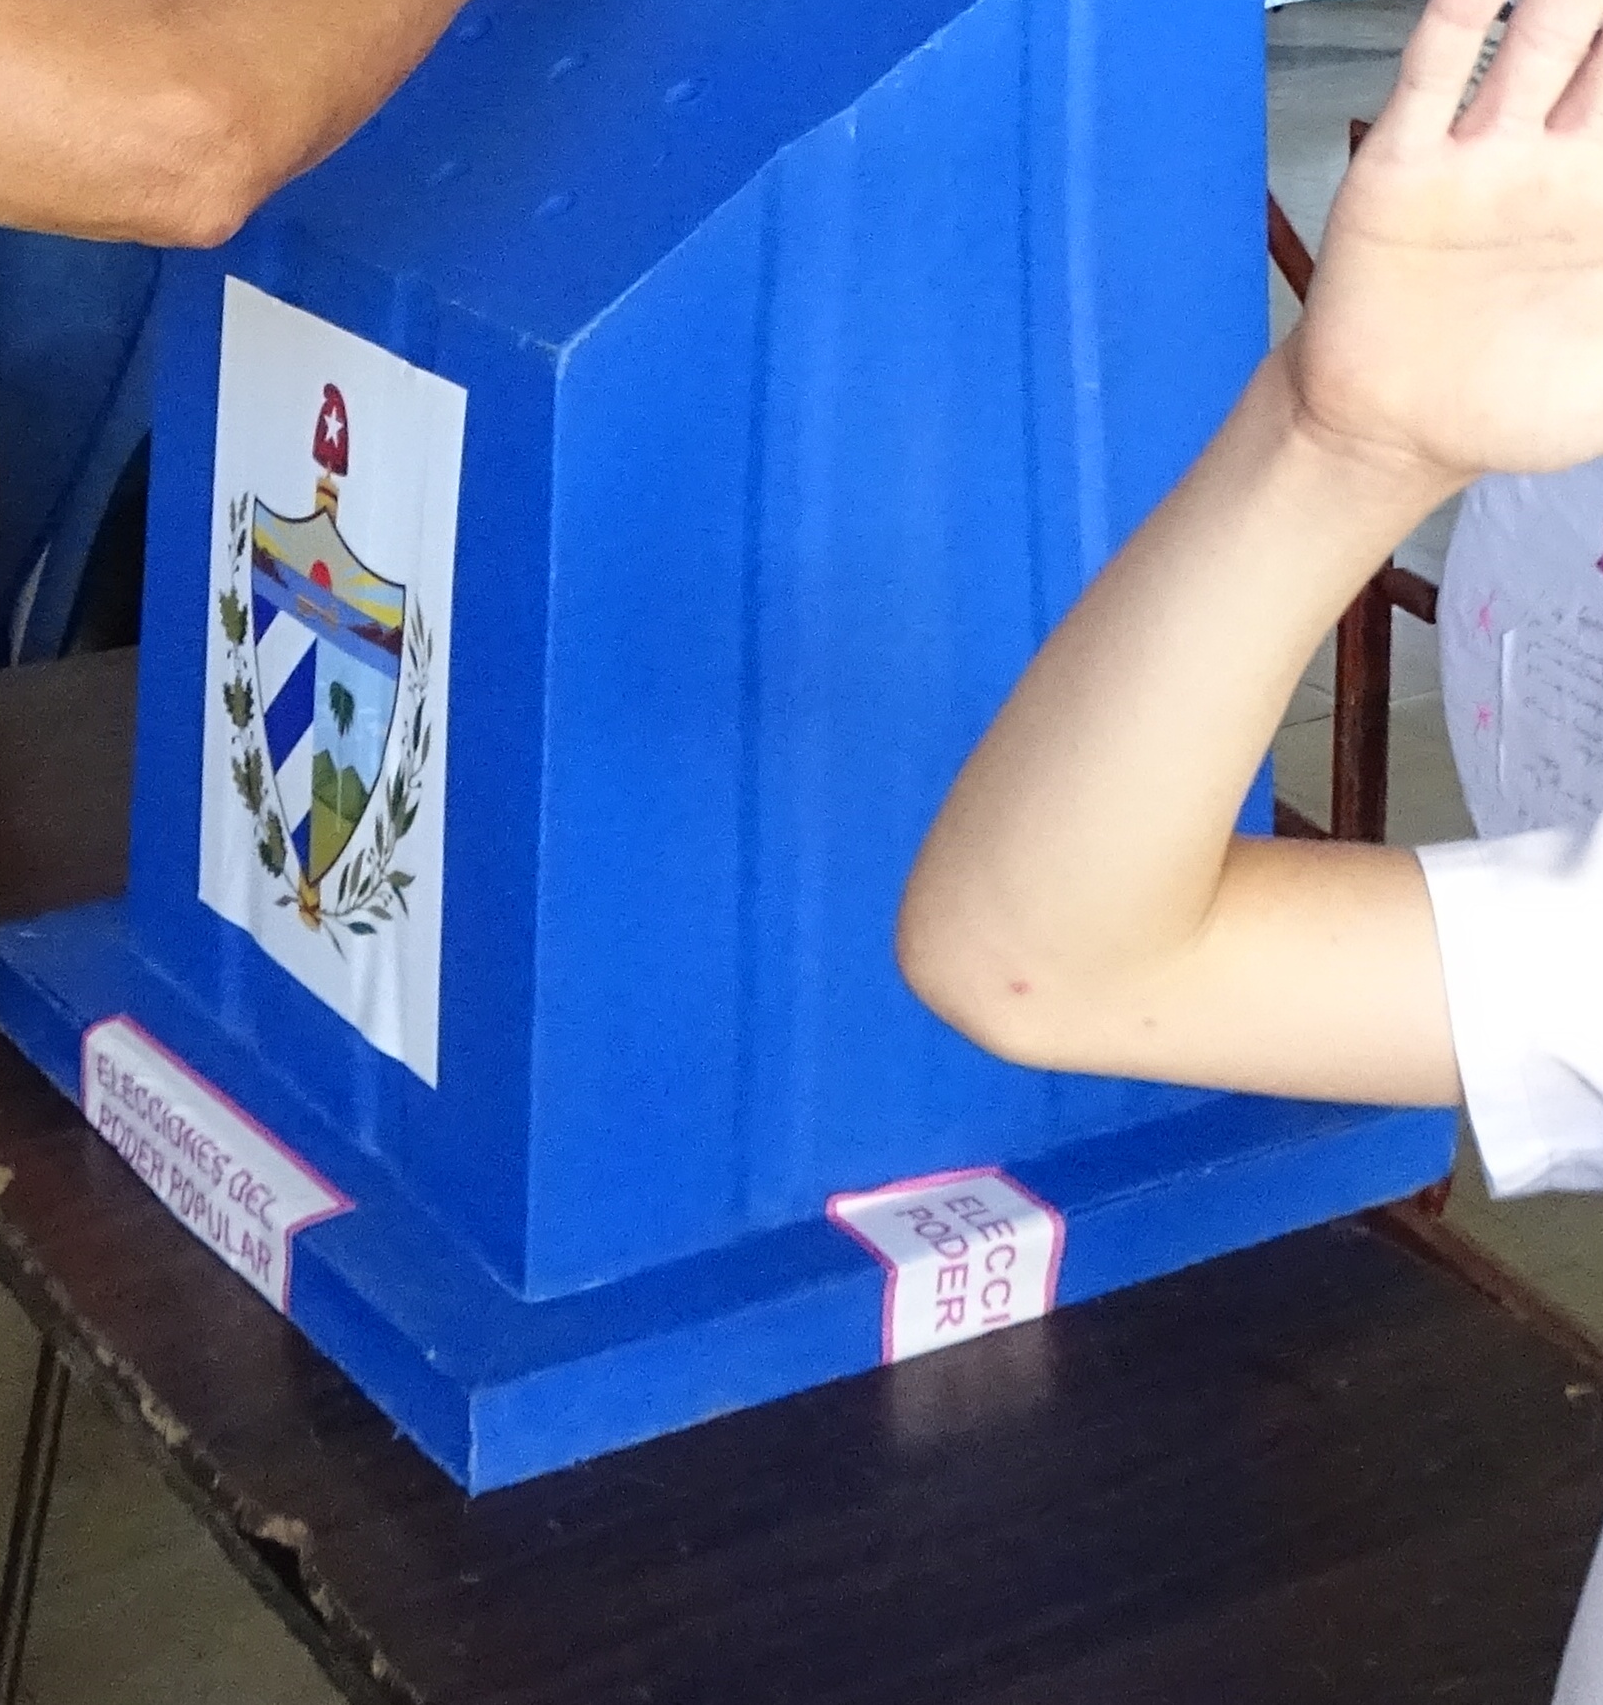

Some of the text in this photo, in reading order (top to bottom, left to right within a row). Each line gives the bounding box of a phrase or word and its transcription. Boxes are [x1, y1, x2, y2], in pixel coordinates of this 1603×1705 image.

[97, 1102, 274, 1284] PODER POPULAR
[893, 1205, 969, 1333] PODER
[943, 1195, 1016, 1325] ELECCI
